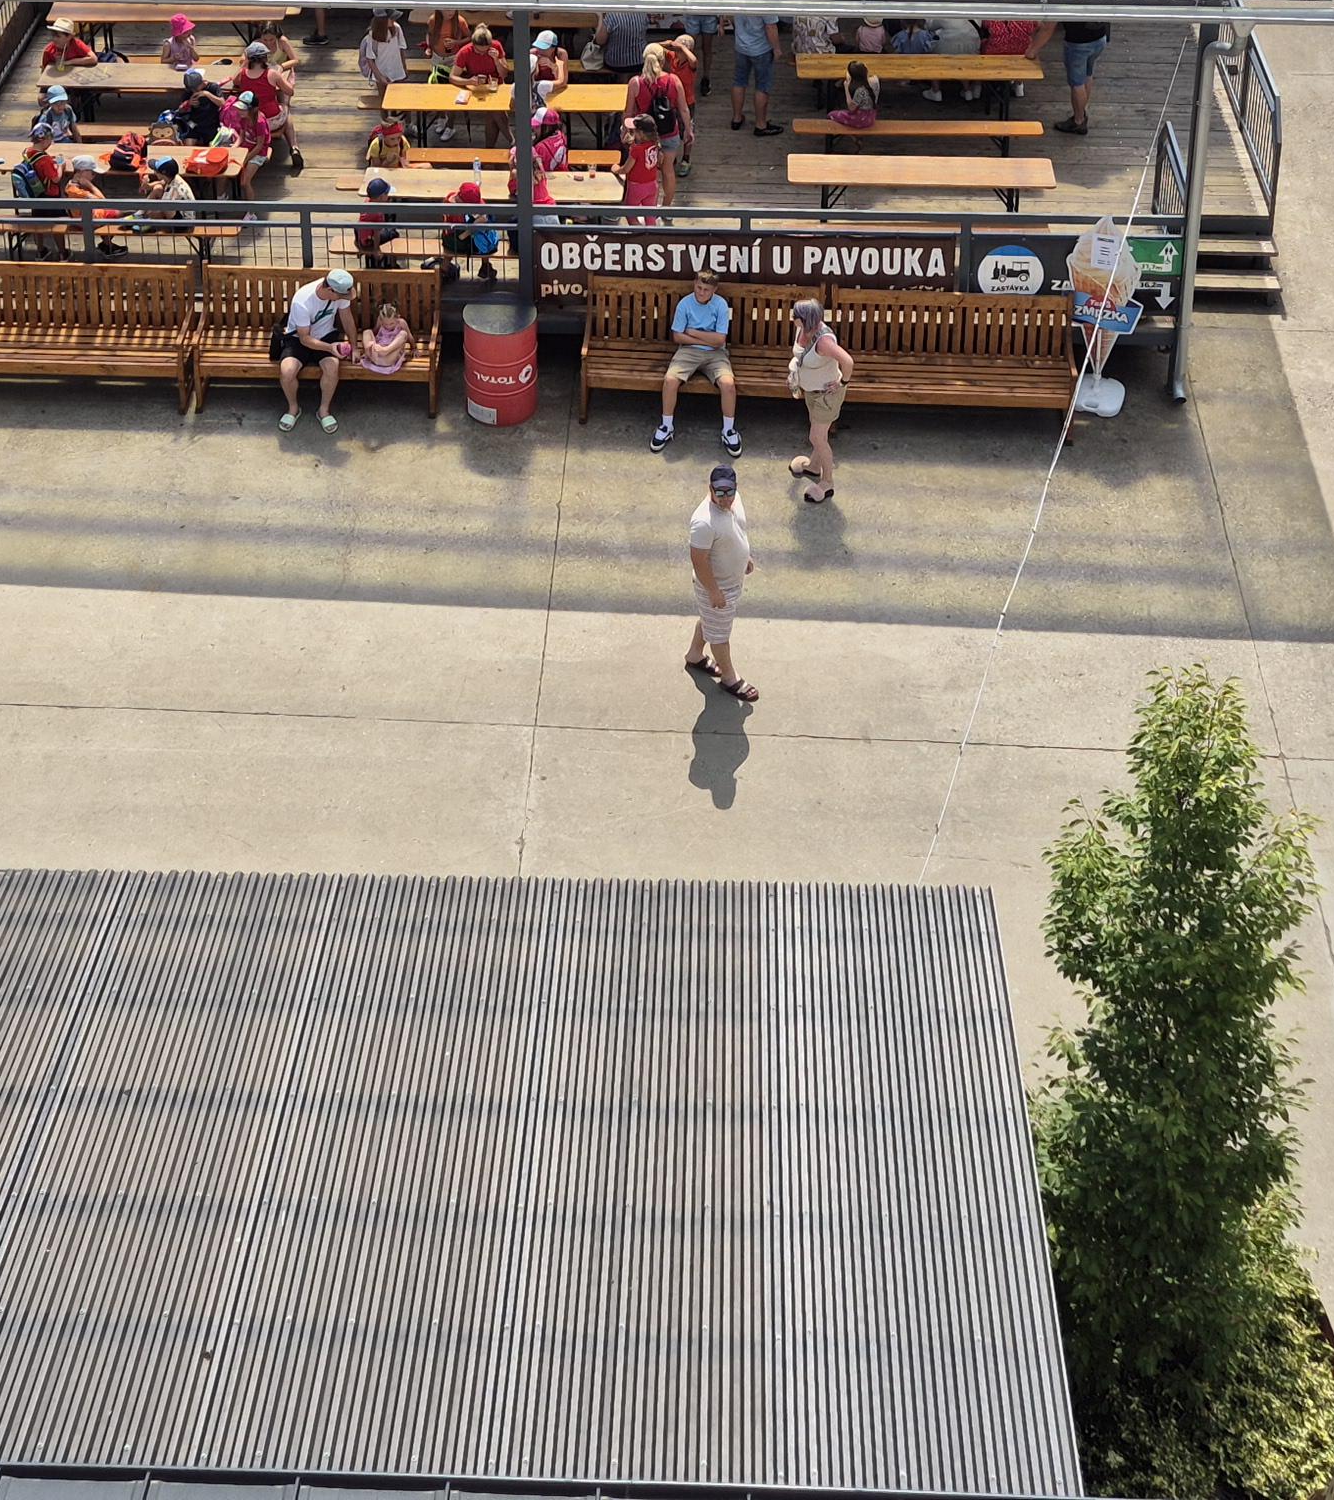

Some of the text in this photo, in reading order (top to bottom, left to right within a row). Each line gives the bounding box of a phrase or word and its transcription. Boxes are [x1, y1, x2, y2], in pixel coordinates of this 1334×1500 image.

[541, 235, 946, 277] OBČERSTVENÍ U PAVOUKA
[991, 284, 1030, 292] ZASTÁVKA
[473, 370, 516, 385] TOTAL
